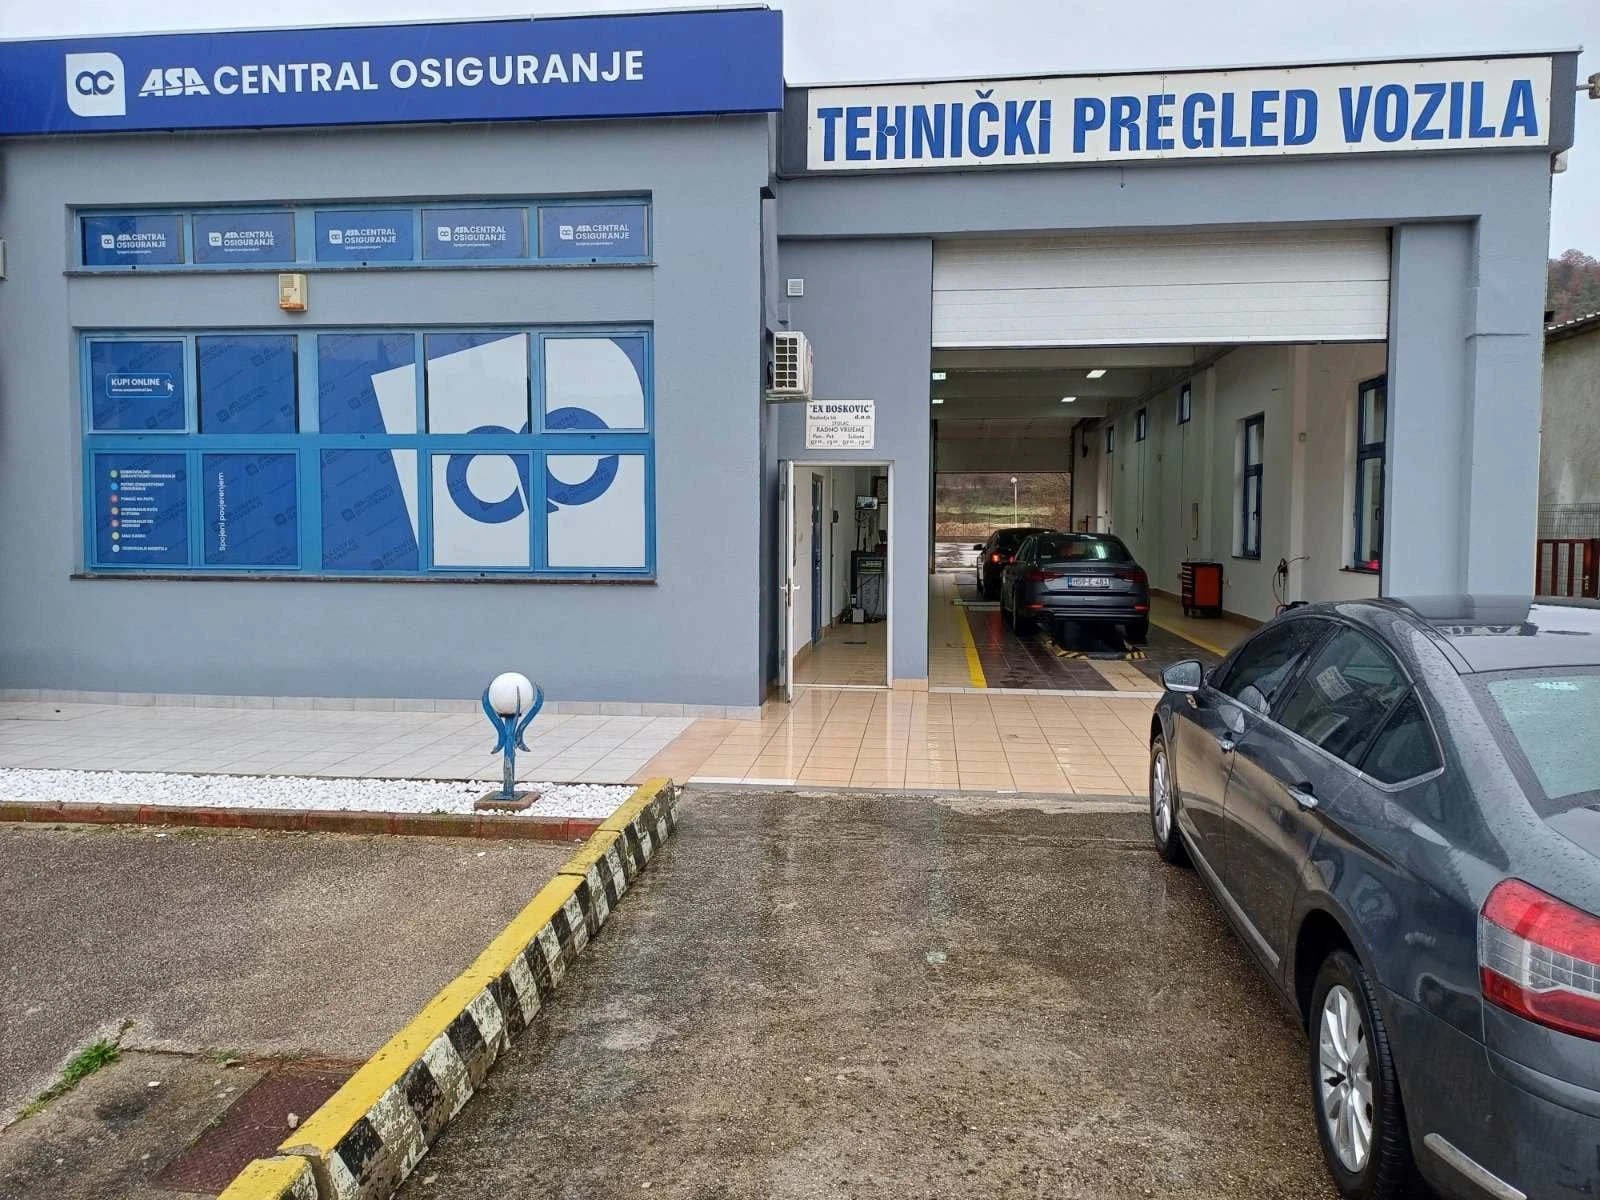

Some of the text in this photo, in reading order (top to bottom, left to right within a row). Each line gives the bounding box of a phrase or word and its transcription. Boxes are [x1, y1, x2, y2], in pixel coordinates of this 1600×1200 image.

[138, 50, 645, 97] ASA CENTRAL OSIGURANJE
[816, 79, 1540, 162] TEHNIČKI PREGLED VOZILA
[361, 228, 396, 236] CENTRAL
[470, 226, 506, 234] CENTRAL
[592, 224, 630, 232] CENTRAL
[132, 233, 166, 241] CENTRAL
[240, 231, 273, 239] CENTRAL
[453, 233, 506, 241] OSIGURANJE
[576, 232, 631, 240] OSIGURANJE
[224, 238, 275, 246] OSIGURANJE
[345, 236, 397, 244] OSIGURANJE
[117, 241, 166, 249] OSIGURANJE
[112, 378, 160, 386] KUPI ONLINE
